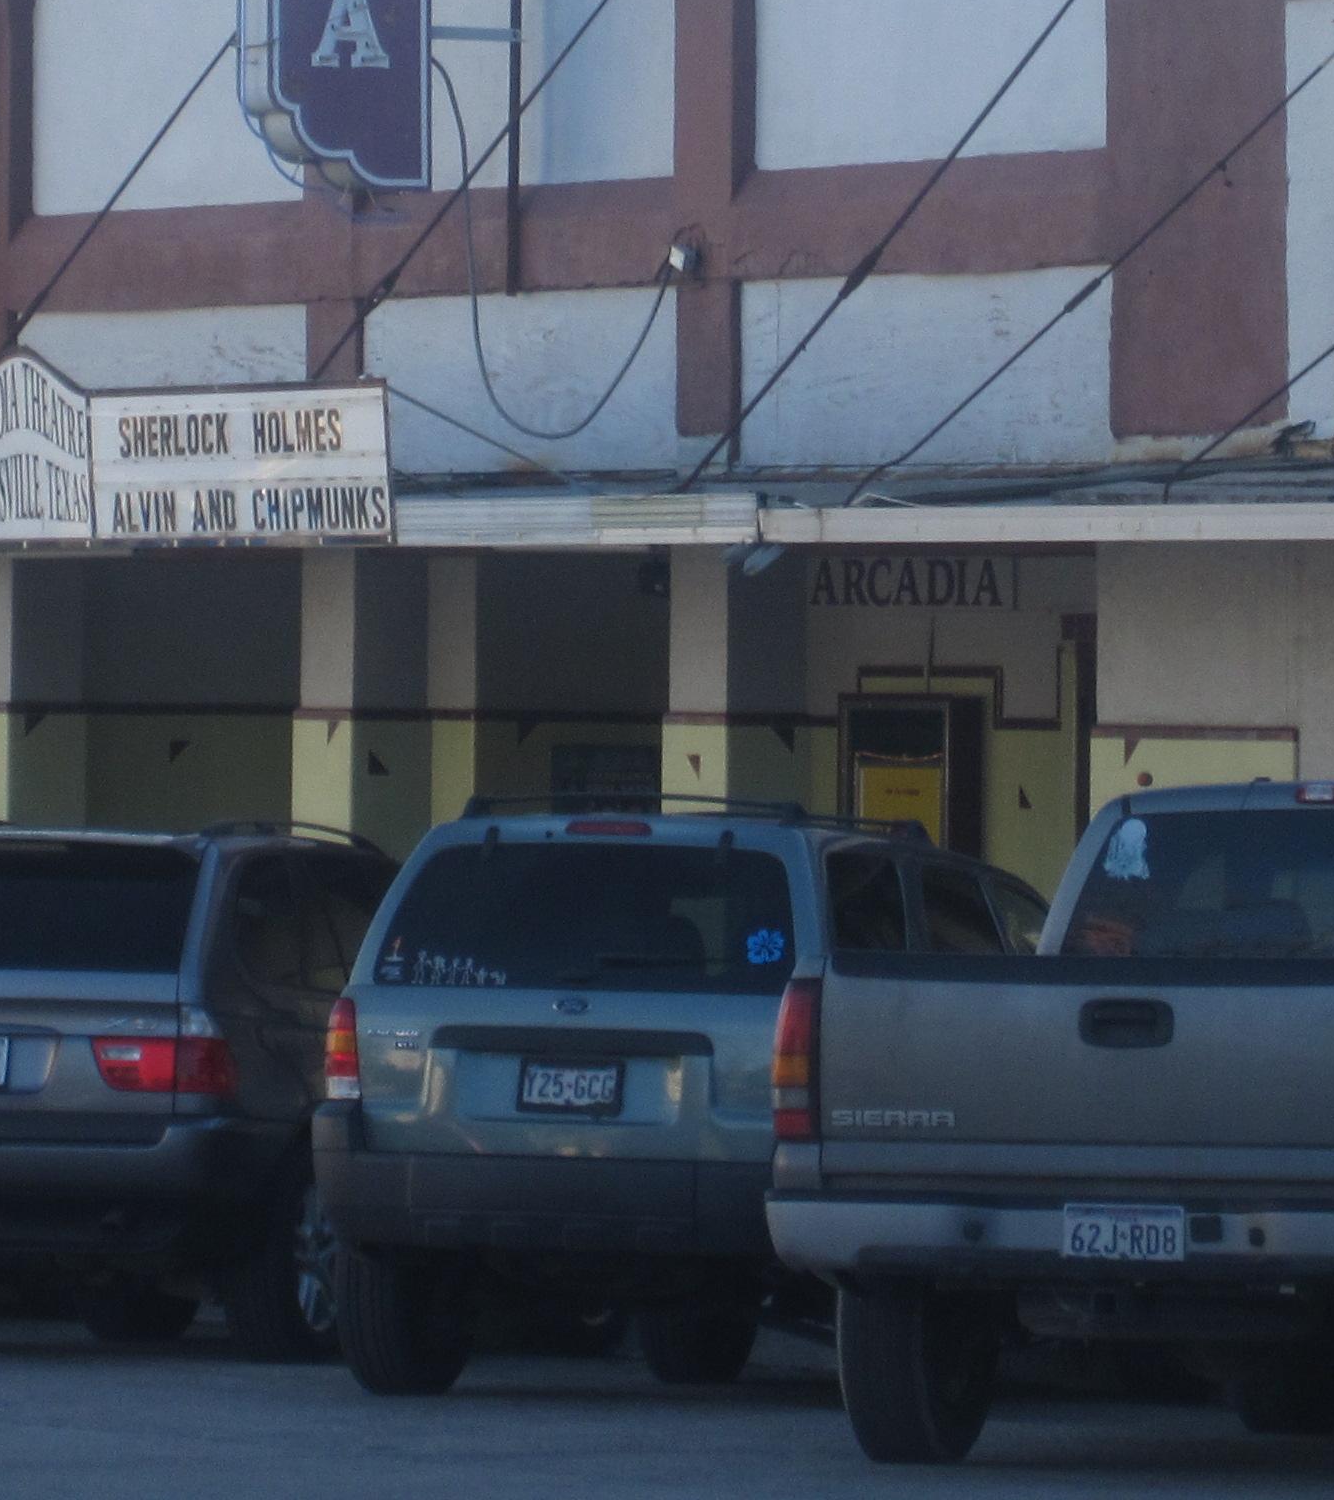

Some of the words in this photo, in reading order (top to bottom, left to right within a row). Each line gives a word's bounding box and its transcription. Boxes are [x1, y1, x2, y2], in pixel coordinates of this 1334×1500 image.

[22, 362, 86, 459] THEATRE
[119, 413, 229, 458] SHERLOCK
[252, 408, 342, 453] HOLMES
[45, 460, 89, 522] TEXAS
[113, 490, 176, 532] ALVIN
[192, 489, 237, 531] AND
[252, 486, 386, 531] CHIPMUNKS
[809, 557, 1003, 607] ARCADIA
[831, 1110, 955, 1127] SIERRA
